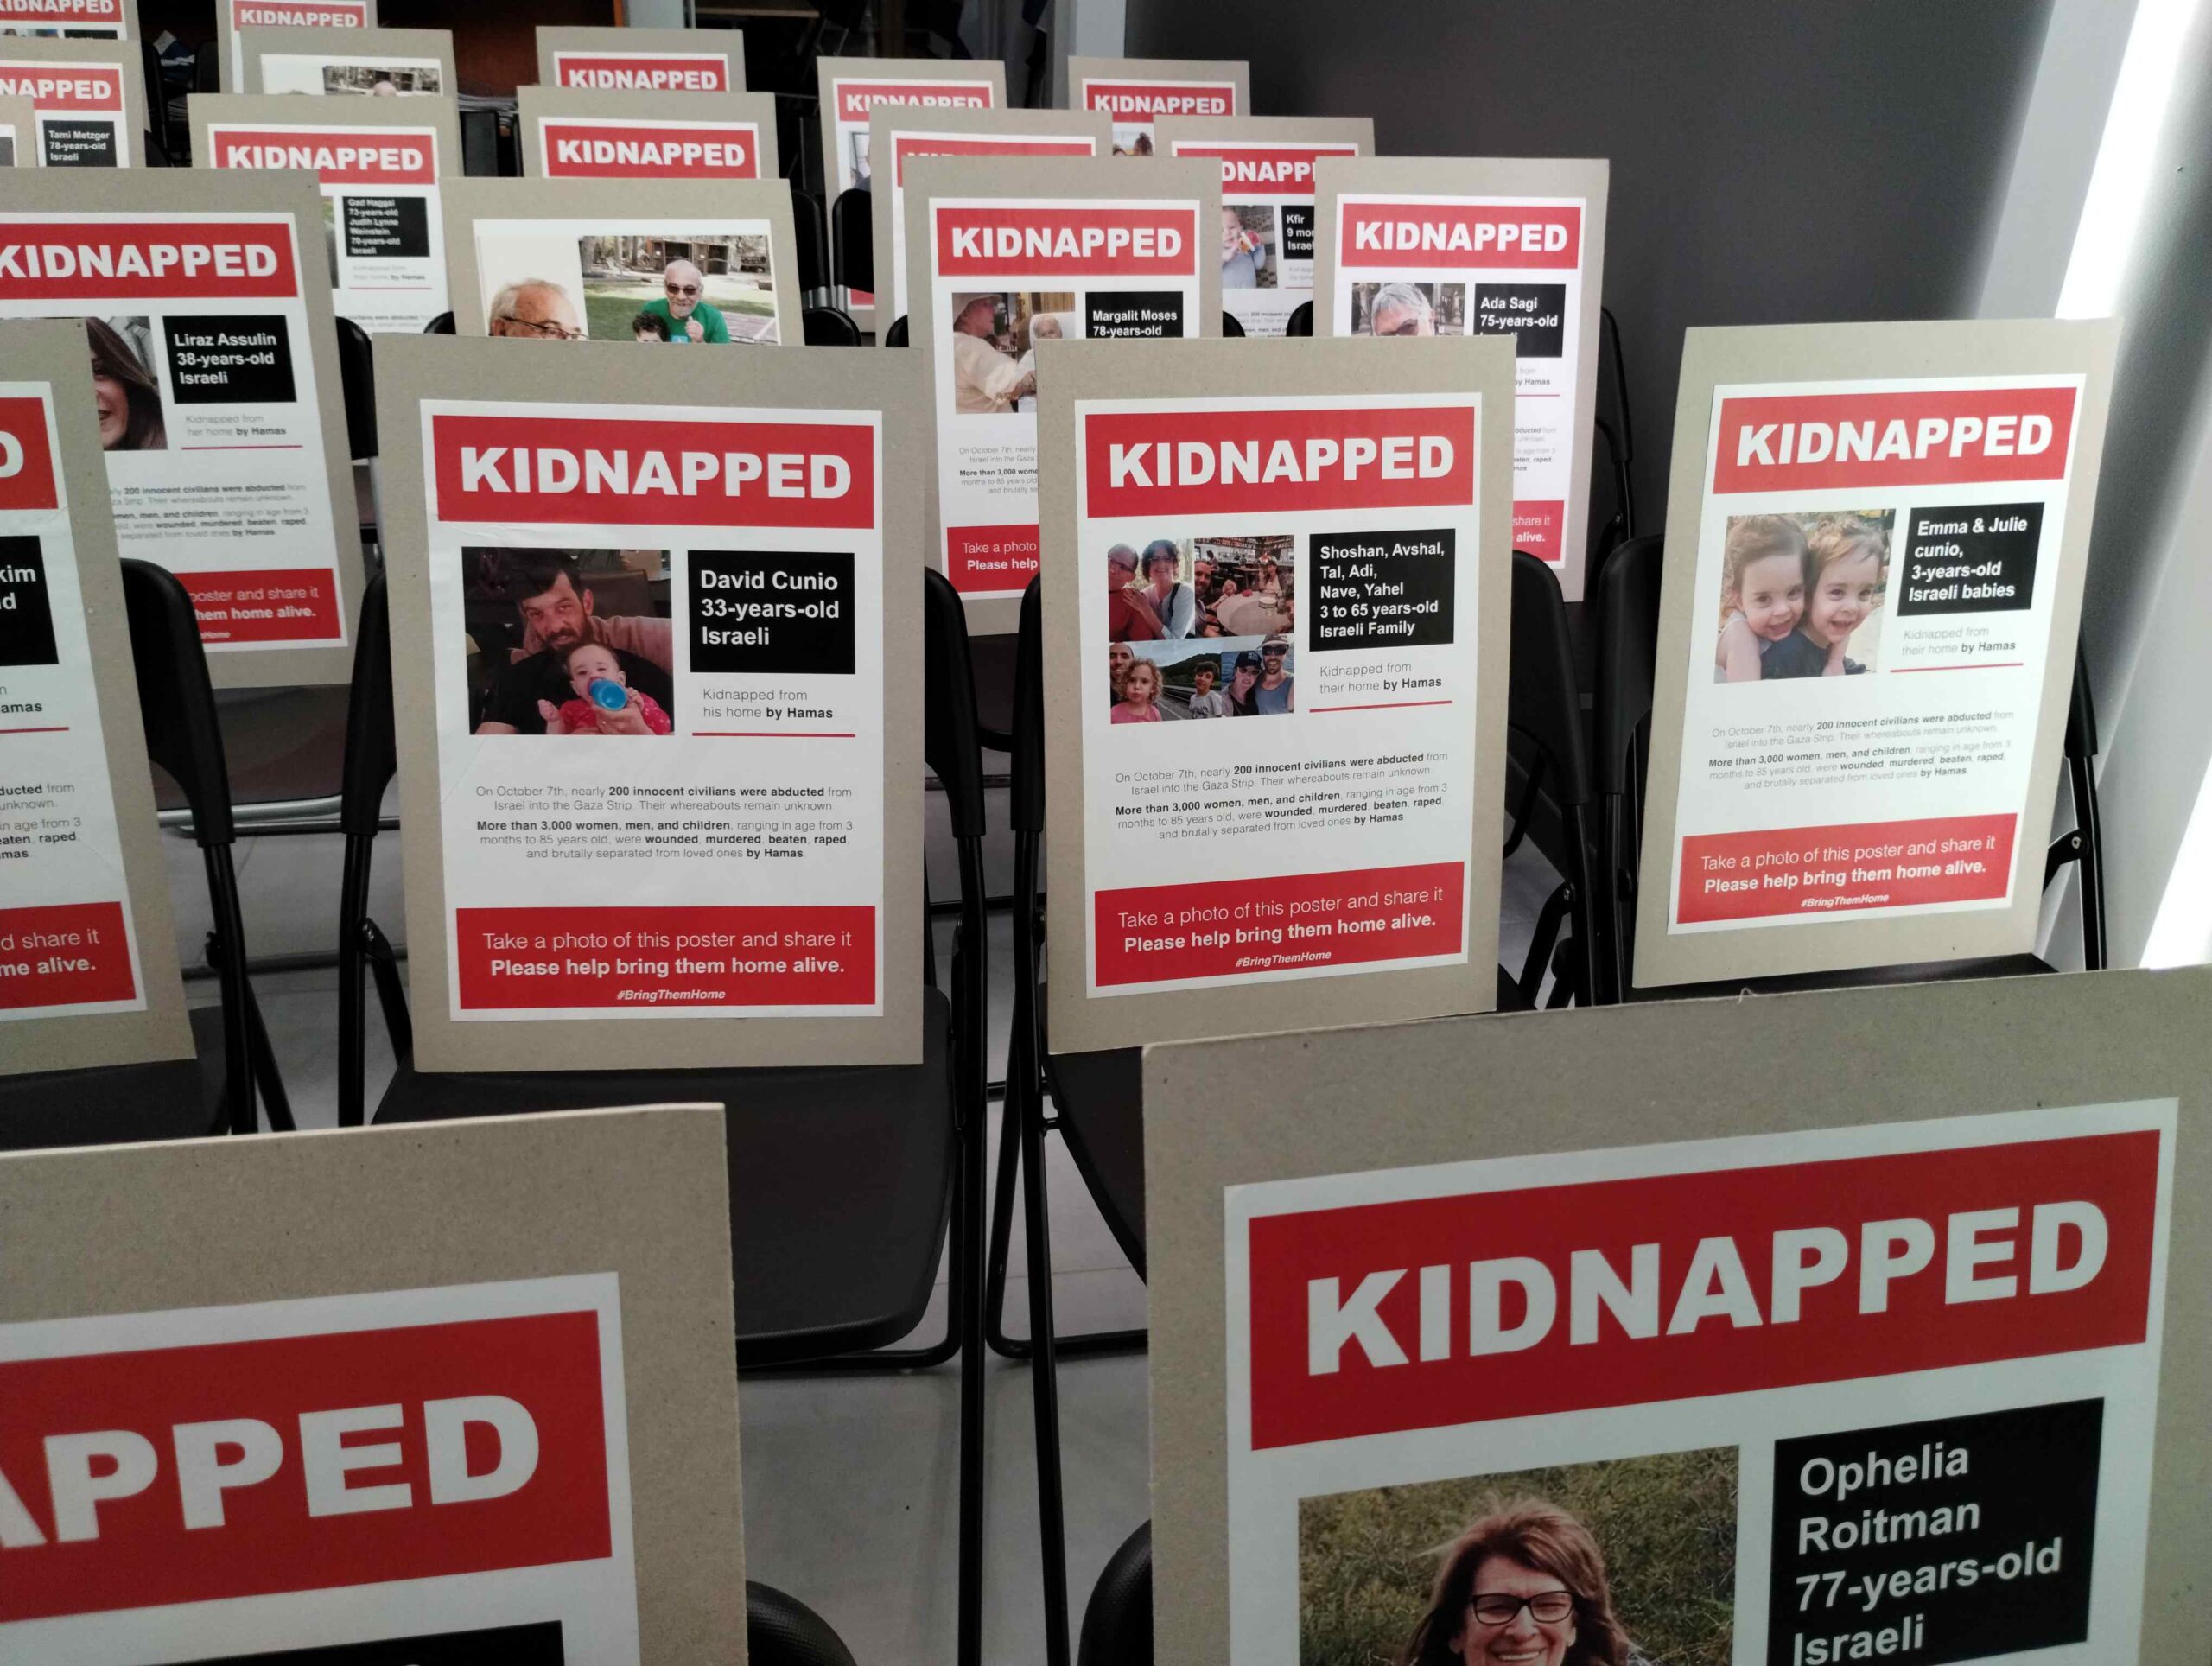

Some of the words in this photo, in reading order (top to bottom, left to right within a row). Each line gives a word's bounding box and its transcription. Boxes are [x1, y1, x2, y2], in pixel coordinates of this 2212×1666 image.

[240, 9, 359, 28] KIDNAPPED
[569, 69, 718, 90] KIDNAPPED
[1095, 93, 1226, 115] KIDNAPPED
[73, 130, 110, 141] Metzger
[49, 141, 106, 151] 78-years-old
[557, 139, 745, 167] KIDNAPPED
[227, 146, 423, 170] KIDNAPPED
[1287, 214, 1305, 224] Kfir
[1287, 227, 1294, 237] 9
[1356, 221, 1567, 251] KIDNAPPED
[952, 227, 1182, 258] KIDNAPPED
[1480, 297, 1506, 309] Ada
[1510, 296, 1537, 312] Sagi
[1093, 310, 1138, 323] Margalit
[1141, 309, 1177, 321] Moses
[1480, 315, 1558, 329] 75-years-old
[1092, 323, 1162, 338] 78-years-old
[175, 334, 214, 347] Liraz
[217, 333, 276, 346] Assulin
[177, 352, 275, 368] 38-years-old
[180, 371, 228, 385] Israeli
[185, 415, 239, 424] Kidnapped
[241, 414, 264, 423] from
[236, 428, 248, 436] by
[1737, 415, 2053, 466] KIDNAPPED
[1110, 436, 1454, 487] KIDNAPPED
[461, 447, 851, 499] KIDNAPPED
[1917, 520, 1968, 536] Emma
[1972, 518, 1985, 533] &
[1988, 516, 2028, 532] Julie
[963, 543, 989, 553] Take
[993, 544, 1000, 553] a
[1004, 541, 1037, 555] photo
[1320, 544, 1388, 559] Shoshan,
[1392, 542, 1445, 556] Avshal,
[1915, 541, 1963, 558] cunio,
[967, 560, 1008, 570] Please
[1011, 558, 1038, 571] help
[1320, 565, 1344, 581] Tal,
[1349, 564, 1377, 579] Adi,
[1911, 561, 2002, 582] 3-years-old
[701, 570, 764, 589] David
[772, 571, 838, 590] Cunio
[1320, 585, 1360, 599] Nave,
[1364, 582, 1403, 596] Yahel
[1909, 584, 1958, 601] Israeli
[1961, 582, 2015, 599] babies
[702, 598, 839, 621] 33-years-old
[1320, 605, 1328, 618] 3
[1332, 605, 1347, 618] to
[1351, 603, 1368, 616] 65
[1372, 600, 1439, 619] years-old
[702, 626, 769, 645] Israeli
[1320, 623, 1363, 638] Israeli
[1368, 620, 1415, 638] Family
[1961, 643, 1974, 654] by
[1978, 642, 2016, 651] Hamas
[1320, 664, 1382, 677] Kidnapped
[1387, 662, 1411, 673] from
[1319, 681, 1344, 694] their
[1348, 682, 1380, 691] home
[1383, 679, 1398, 692] by
[1402, 678, 1442, 688] Hamas
[703, 689, 774, 703] Kidnapped
[779, 689, 807, 701] from
[703, 707, 721, 717] his
[726, 706, 762, 718] home
[766, 707, 782, 721] by
[787, 707, 833, 718] Hamas
[476, 786, 493, 797] On
[497, 785, 543, 797] October
[571, 786, 606, 798] nearly
[609, 786, 629, 796] 200
[633, 786, 684, 796] innocent
[688, 786, 736, 796] civilians
[771, 787, 824, 797] abducted
[1701, 855, 1736, 870] Take
[1740, 856, 1750, 868] a
[1755, 851, 1799, 869] photo
[1803, 848, 1819, 862] of
[1823, 847, 1850, 862] this
[1854, 844, 1904, 862] poster
[1907, 839, 1936, 855] and
[1940, 838, 1982, 853] share
[1986, 836, 1995, 849] it
[1705, 878, 1758, 893] Please
[1764, 873, 1799, 890] help
[1803, 870, 1847, 887] bring
[1851, 868, 1891, 882] them
[1897, 865, 1942, 879] home
[1945, 860, 1986, 875] alive.
[1118, 912, 1158, 928] Take
[1164, 912, 1174, 925] a
[1180, 906, 1229, 926] photo
[1234, 902, 1250, 919] of
[1255, 900, 1284, 917] this
[1290, 898, 1342, 918] poster
[1347, 892, 1378, 909] and
[1384, 890, 1429, 906] share
[1434, 887, 1443, 901] it
[1801, 894, 1890, 908] #BringThemHome
[482, 933, 528, 950] Take
[535, 936, 546, 949] a
[553, 932, 607, 952] photo
[613, 932, 632, 948] of
[637, 932, 670, 948] this
[677, 932, 736, 951] poster
[742, 931, 777, 947] and
[784, 931, 836, 947] share
[841, 930, 852, 947] it
[1125, 937, 1185, 952] Please
[1192, 930, 1230, 948] help
[1236, 926, 1282, 944] bring
[1287, 923, 1332, 938] them
[1338, 916, 1386, 934] home
[1391, 913, 1435, 929] alive.
[491, 960, 560, 976] Please
[566, 958, 610, 978] help
[616, 958, 669, 978] bring
[675, 957, 725, 974] them
[732, 957, 787, 973] home
[793, 957, 844, 973] alive.
[1236, 951, 1332, 967] #BringThemHome
[617, 989, 726, 1002] #BringThemHome
[1306, 1199, 2111, 1377] KIDNAPPED
[1798, 1440, 1972, 1502] Ophelia
[1796, 1497, 1982, 1555] Roitman
[1796, 1537, 2062, 1612] 77-years-old
[1791, 1609, 1926, 1665] Israeli
